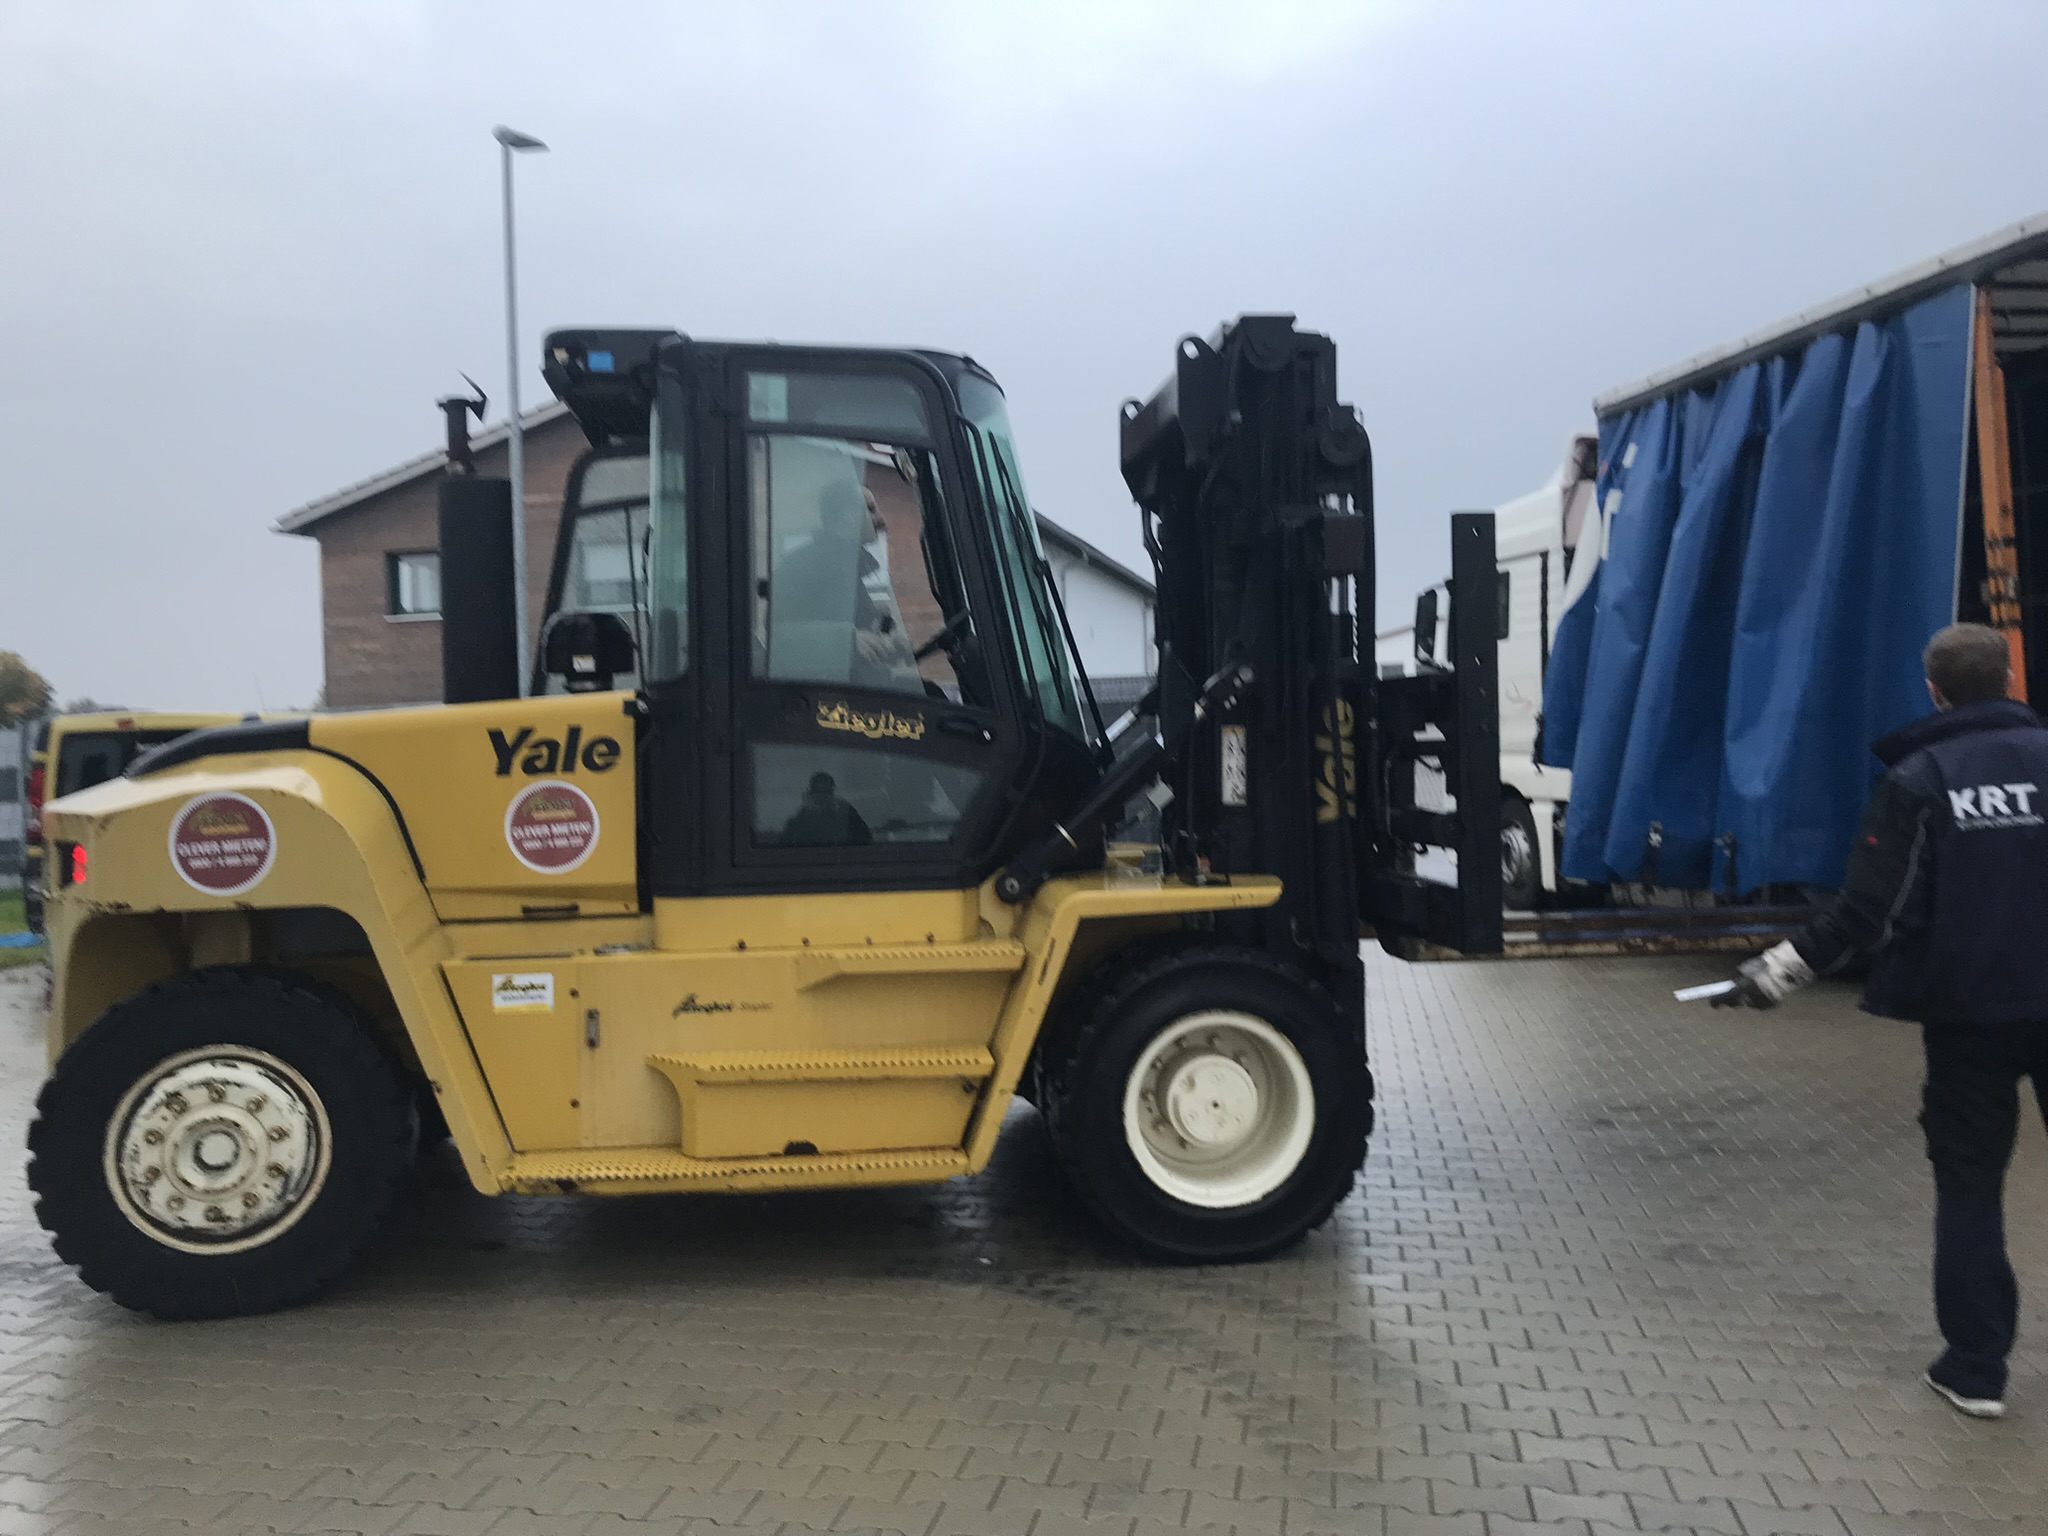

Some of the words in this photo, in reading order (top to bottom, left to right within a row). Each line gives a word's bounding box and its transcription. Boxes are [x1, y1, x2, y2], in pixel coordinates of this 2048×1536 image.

[487, 725, 621, 776] Yale
[1315, 698, 1356, 823] Yale
[1948, 783, 2038, 819] KRT
